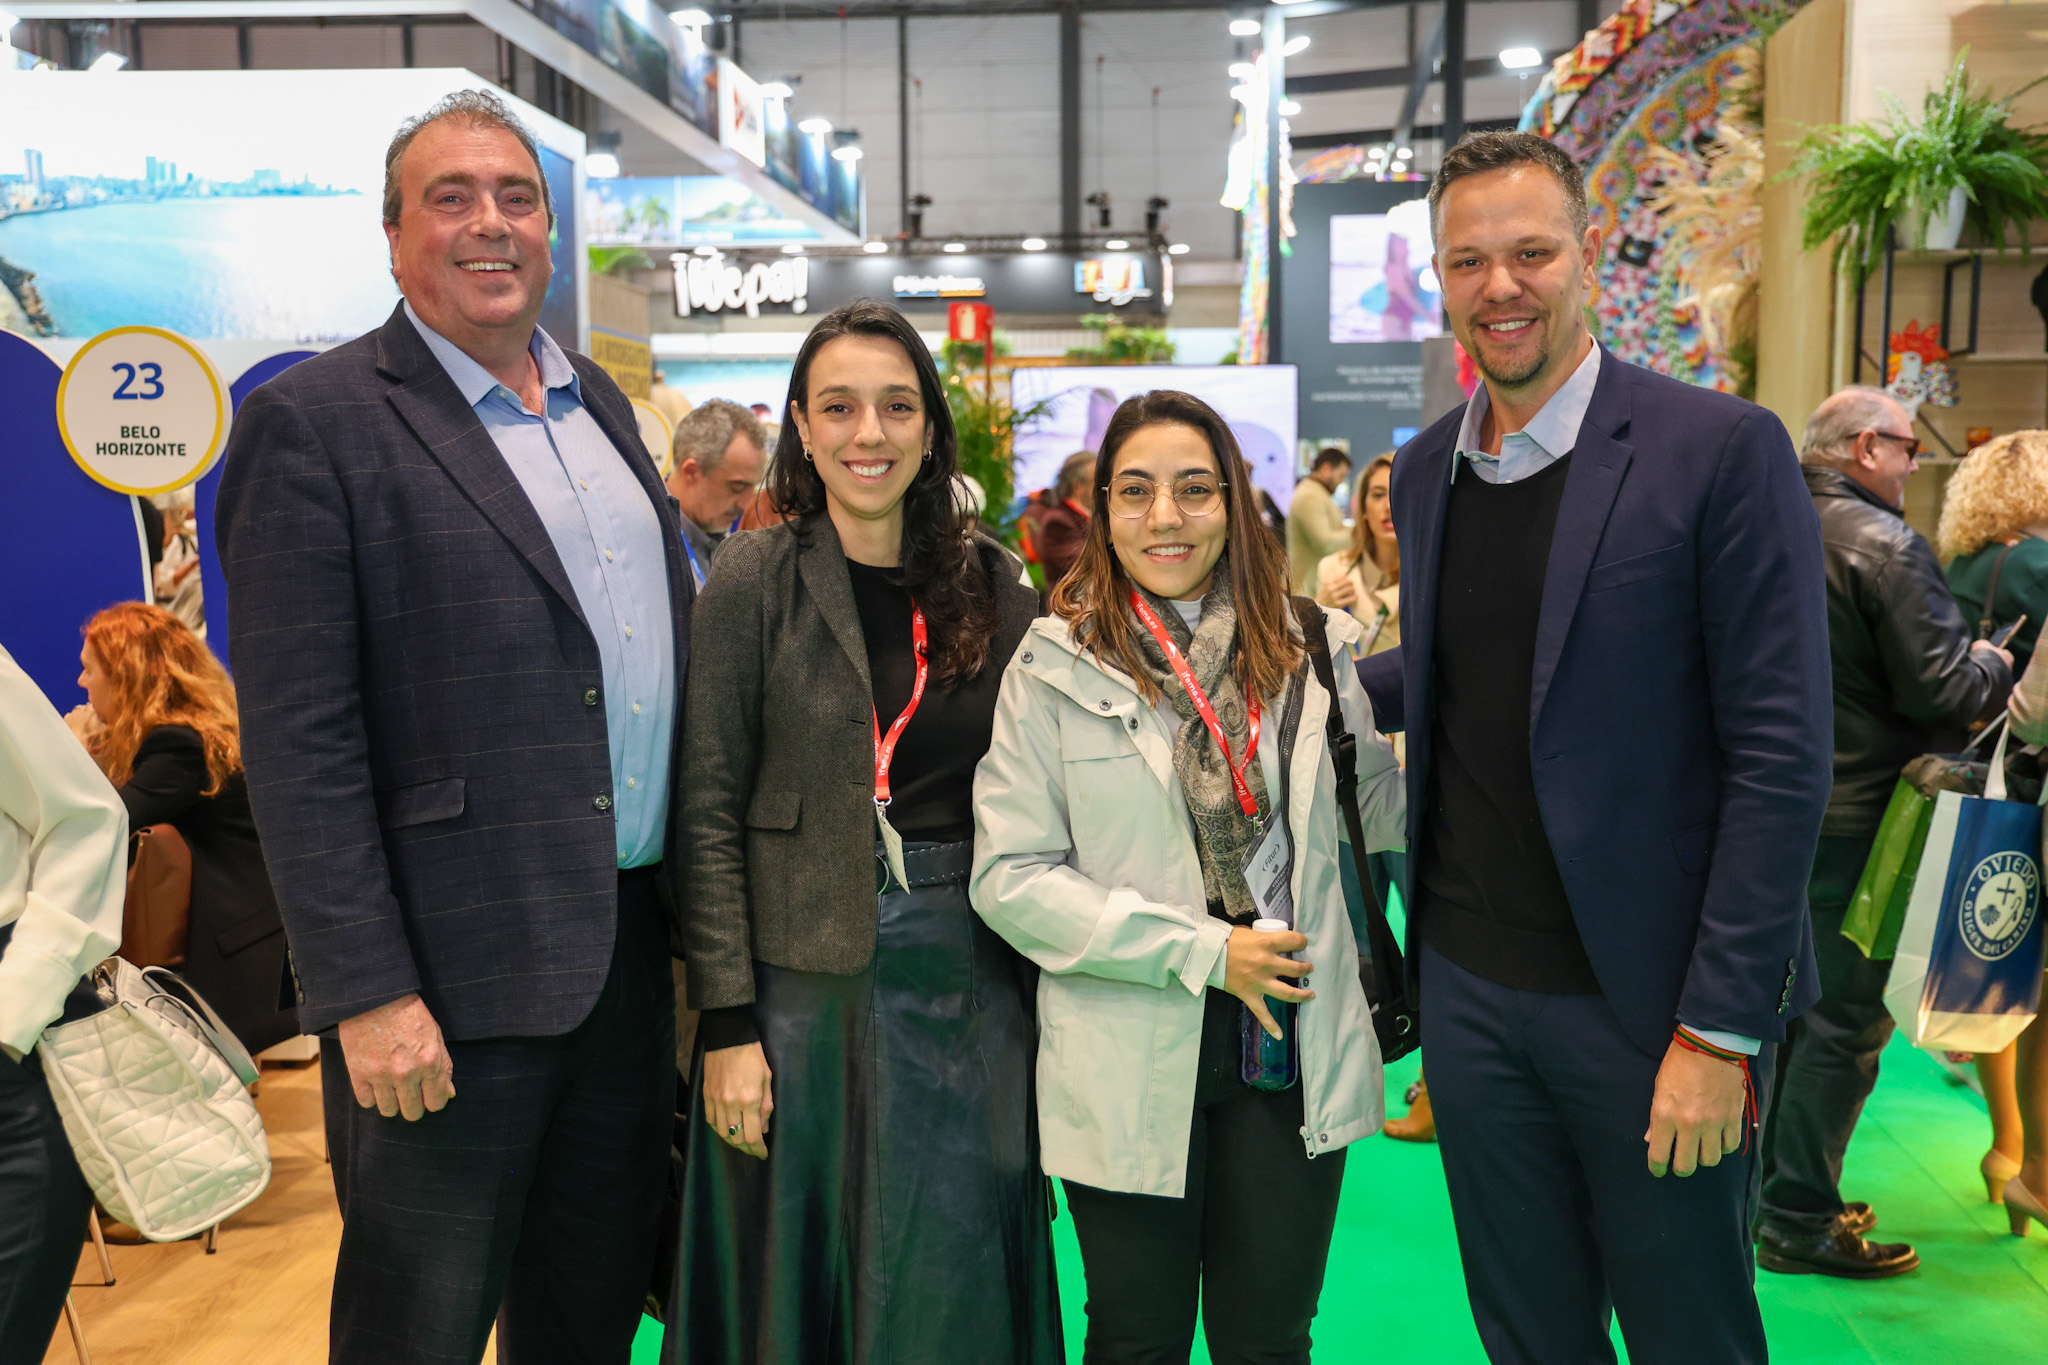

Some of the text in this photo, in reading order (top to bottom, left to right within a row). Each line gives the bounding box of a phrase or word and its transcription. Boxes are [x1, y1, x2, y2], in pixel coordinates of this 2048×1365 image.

[111, 362, 165, 401] 23
[120, 426, 161, 439] BELO
[96, 443, 187, 457] HORIZONTE
[1135, 601, 1159, 630] ifema.es
[1181, 670, 1205, 709] ifema.es
[878, 745, 892, 777] ifema.es
[1978, 855, 2036, 890] OVIEDO
